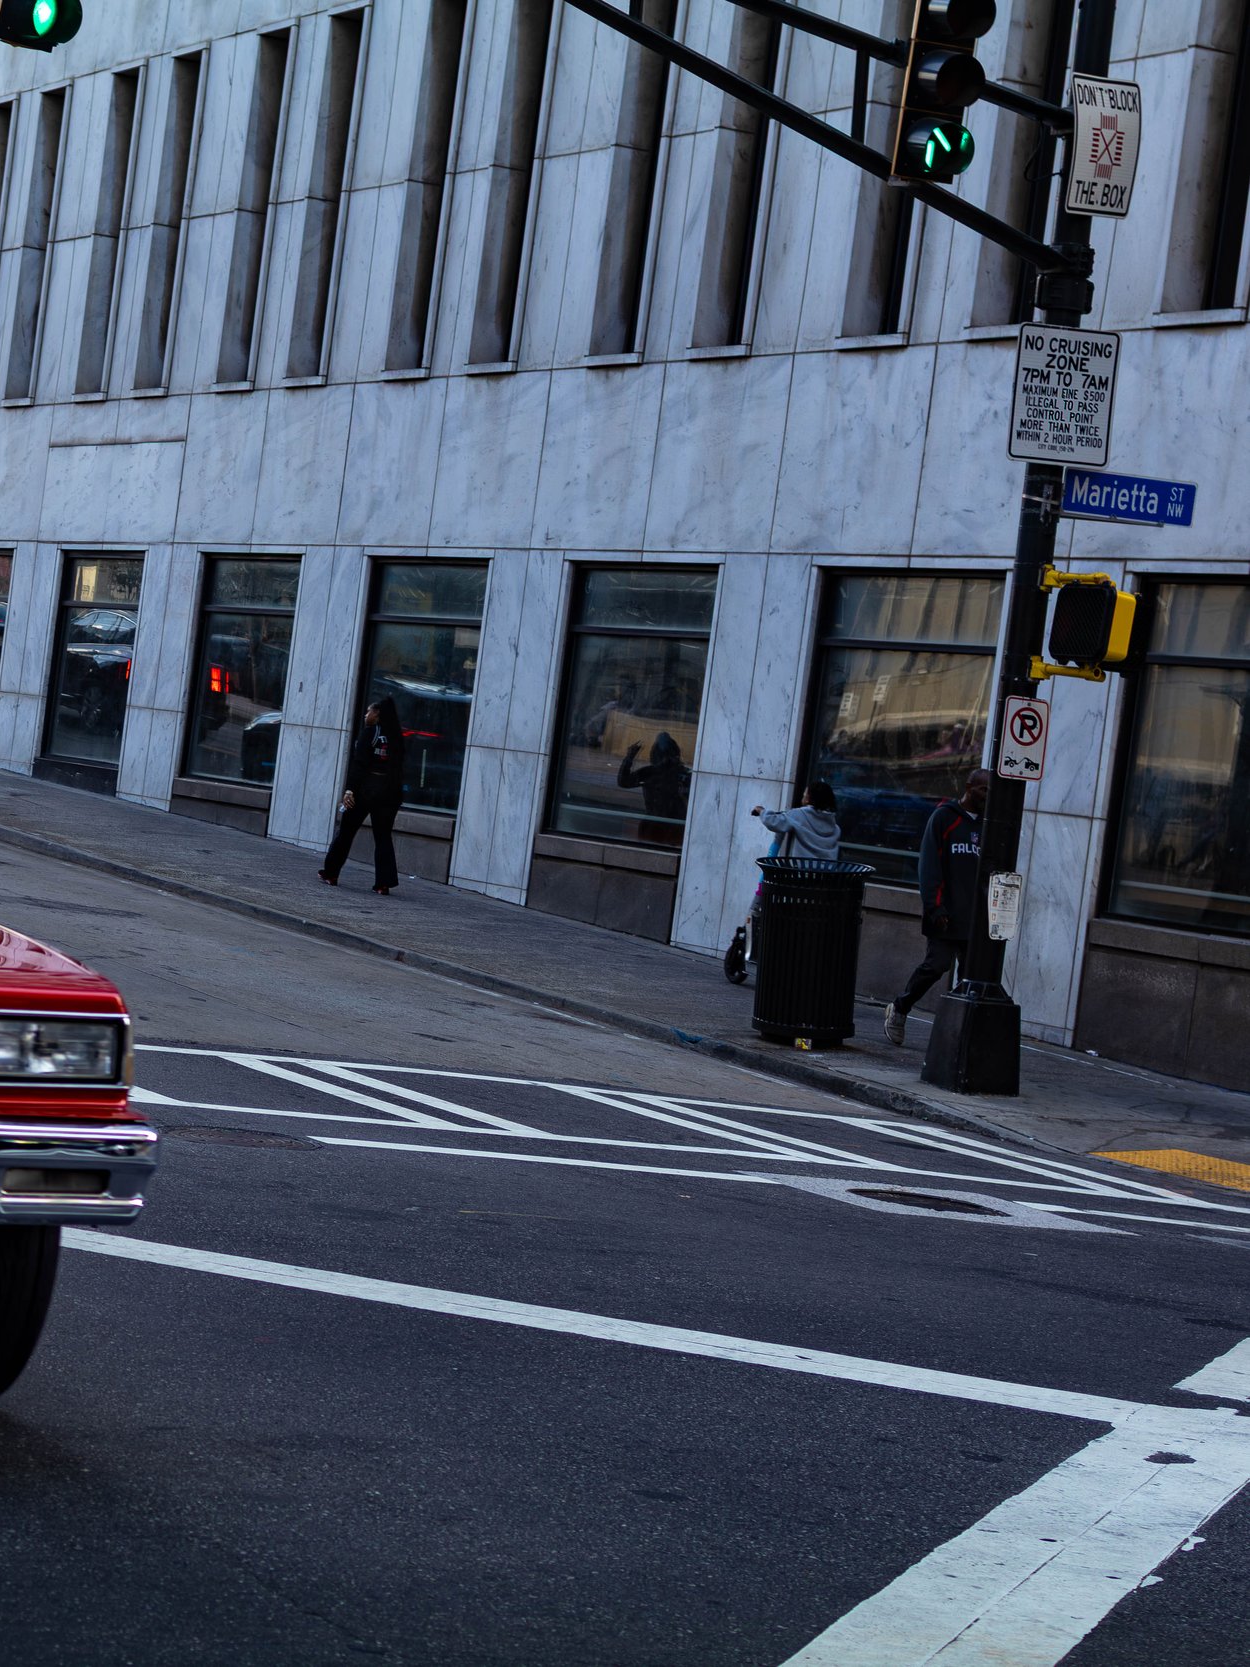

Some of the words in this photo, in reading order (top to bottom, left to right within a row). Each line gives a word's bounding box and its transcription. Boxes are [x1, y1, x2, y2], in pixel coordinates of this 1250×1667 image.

[1077, 84, 1104, 108] DON'T
[1109, 89, 1139, 113] BLOCK
[1075, 180, 1097, 205] THE
[1100, 183, 1127, 209] BOX
[1025, 335, 1044, 351] NO
[1049, 337, 1112, 358] CRUISING
[1045, 353, 1090, 372] ZONE
[1022, 367, 1050, 385] 7PM
[1056, 371, 1072, 387] TO
[1081, 374, 1109, 391] 7AM
[1022, 384, 1058, 397] MAXIMUM
[1083, 390, 1105, 402] $500
[1025, 395, 1059, 409] ILLEGAL
[1063, 399, 1073, 411] TO
[1077, 401, 1099, 414] PASS
[1026, 408, 1065, 421] CONTROL
[1070, 412, 1094, 424] POINT
[1020, 418, 1044, 431] MORE
[1048, 421, 1070, 433] THAN
[1074, 424, 1100, 437] TWICE
[1016, 430, 1041, 442] WITHIN
[1043, 432, 1050, 443] 2
[1052, 434, 1073, 445] HOUR
[1076, 436, 1103, 448] PERIOD
[1071, 475, 1159, 515] Marietta
[1169, 487, 1185, 502] ST
[1166, 503, 1184, 518] NW
